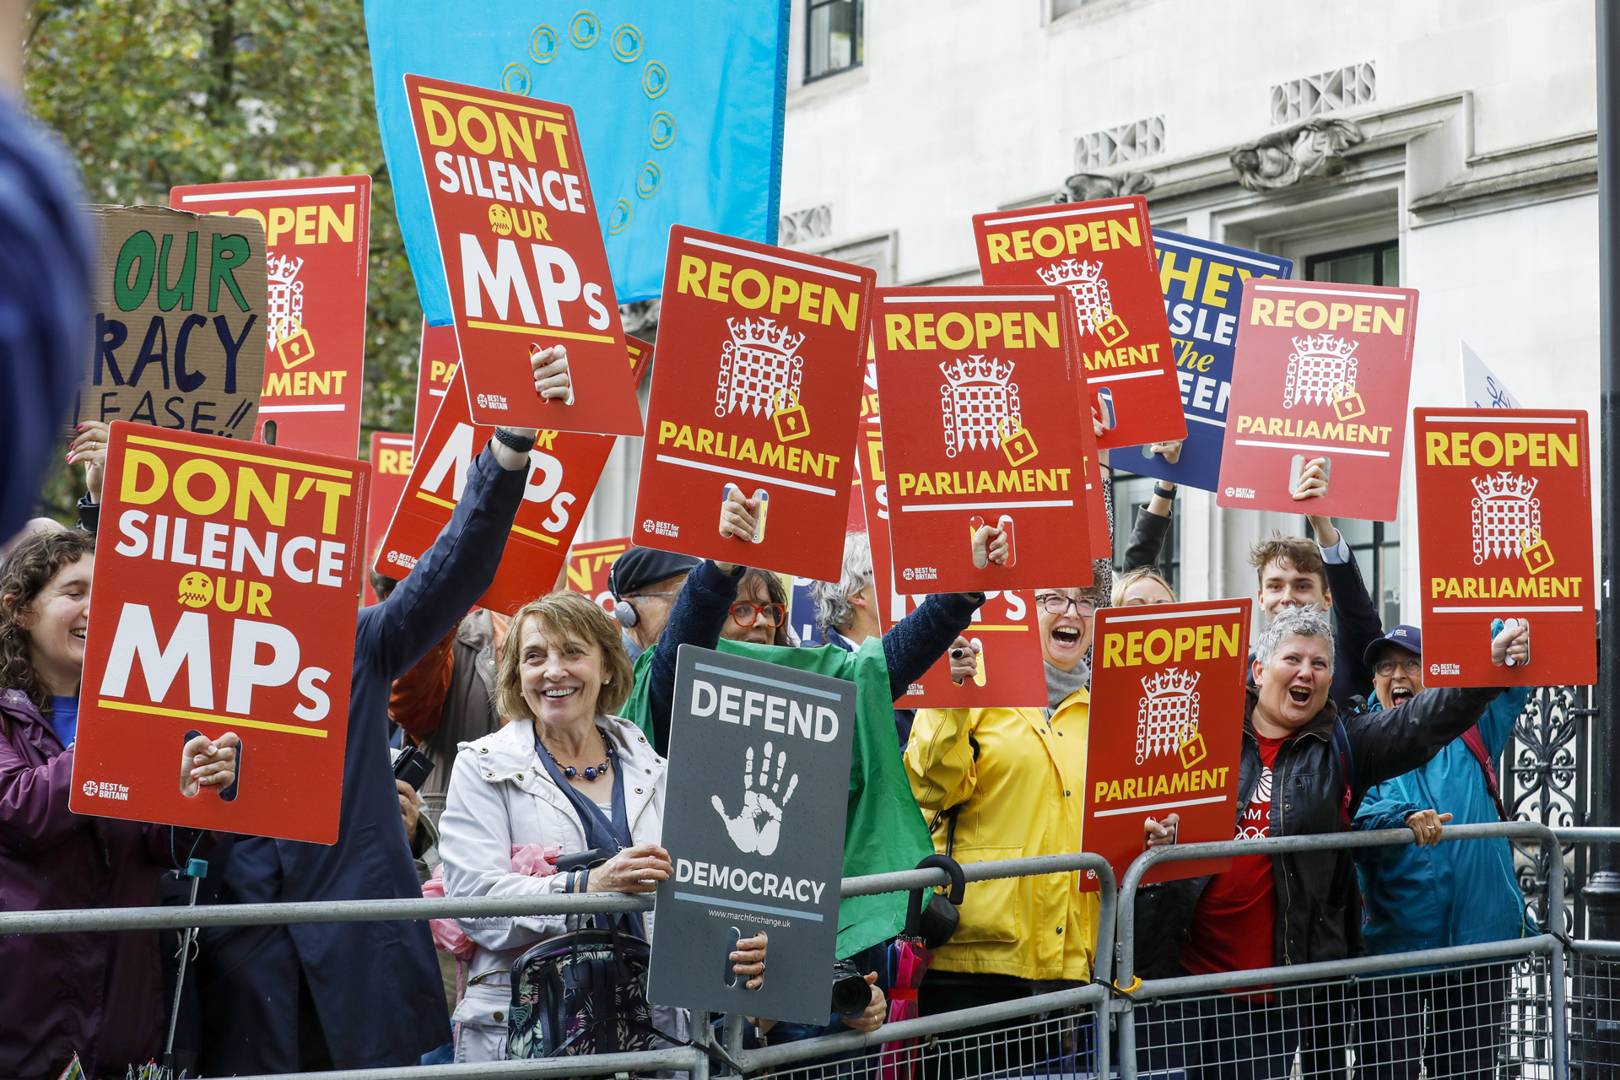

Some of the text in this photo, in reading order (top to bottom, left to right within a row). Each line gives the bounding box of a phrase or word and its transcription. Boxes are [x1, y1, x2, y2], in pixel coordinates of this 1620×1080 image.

[420, 97, 568, 168] DON'T
[434, 151, 586, 214] SILENCE
[986, 217, 1142, 264] REOPEN
[114, 230, 253, 312] OUR
[677, 255, 859, 331] REOPEN
[885, 312, 1060, 350] REOPEN
[1250, 297, 1406, 336] REOPEN
[658, 420, 841, 480] PARLIAMENT
[1235, 415, 1393, 445] PARLIAMENT
[1426, 431, 1578, 467] REOPEN
[119, 449, 352, 535] DON'T
[898, 468, 1072, 497] PARLIAMENT
[115, 509, 346, 588] SILENCE
[1431, 577, 1582, 599] PARLIAMENT
[1103, 623, 1240, 668] REOPEN
[690, 679, 840, 743] DEFEND
[98, 790, 128, 800] BRITAIN
[99, 782, 129, 792] BEST for
[1094, 767, 1230, 803] PARLIAMENT
[675, 858, 826, 905] DEMOCRACY
[708, 909, 791, 928] www.marchforchange.uk
